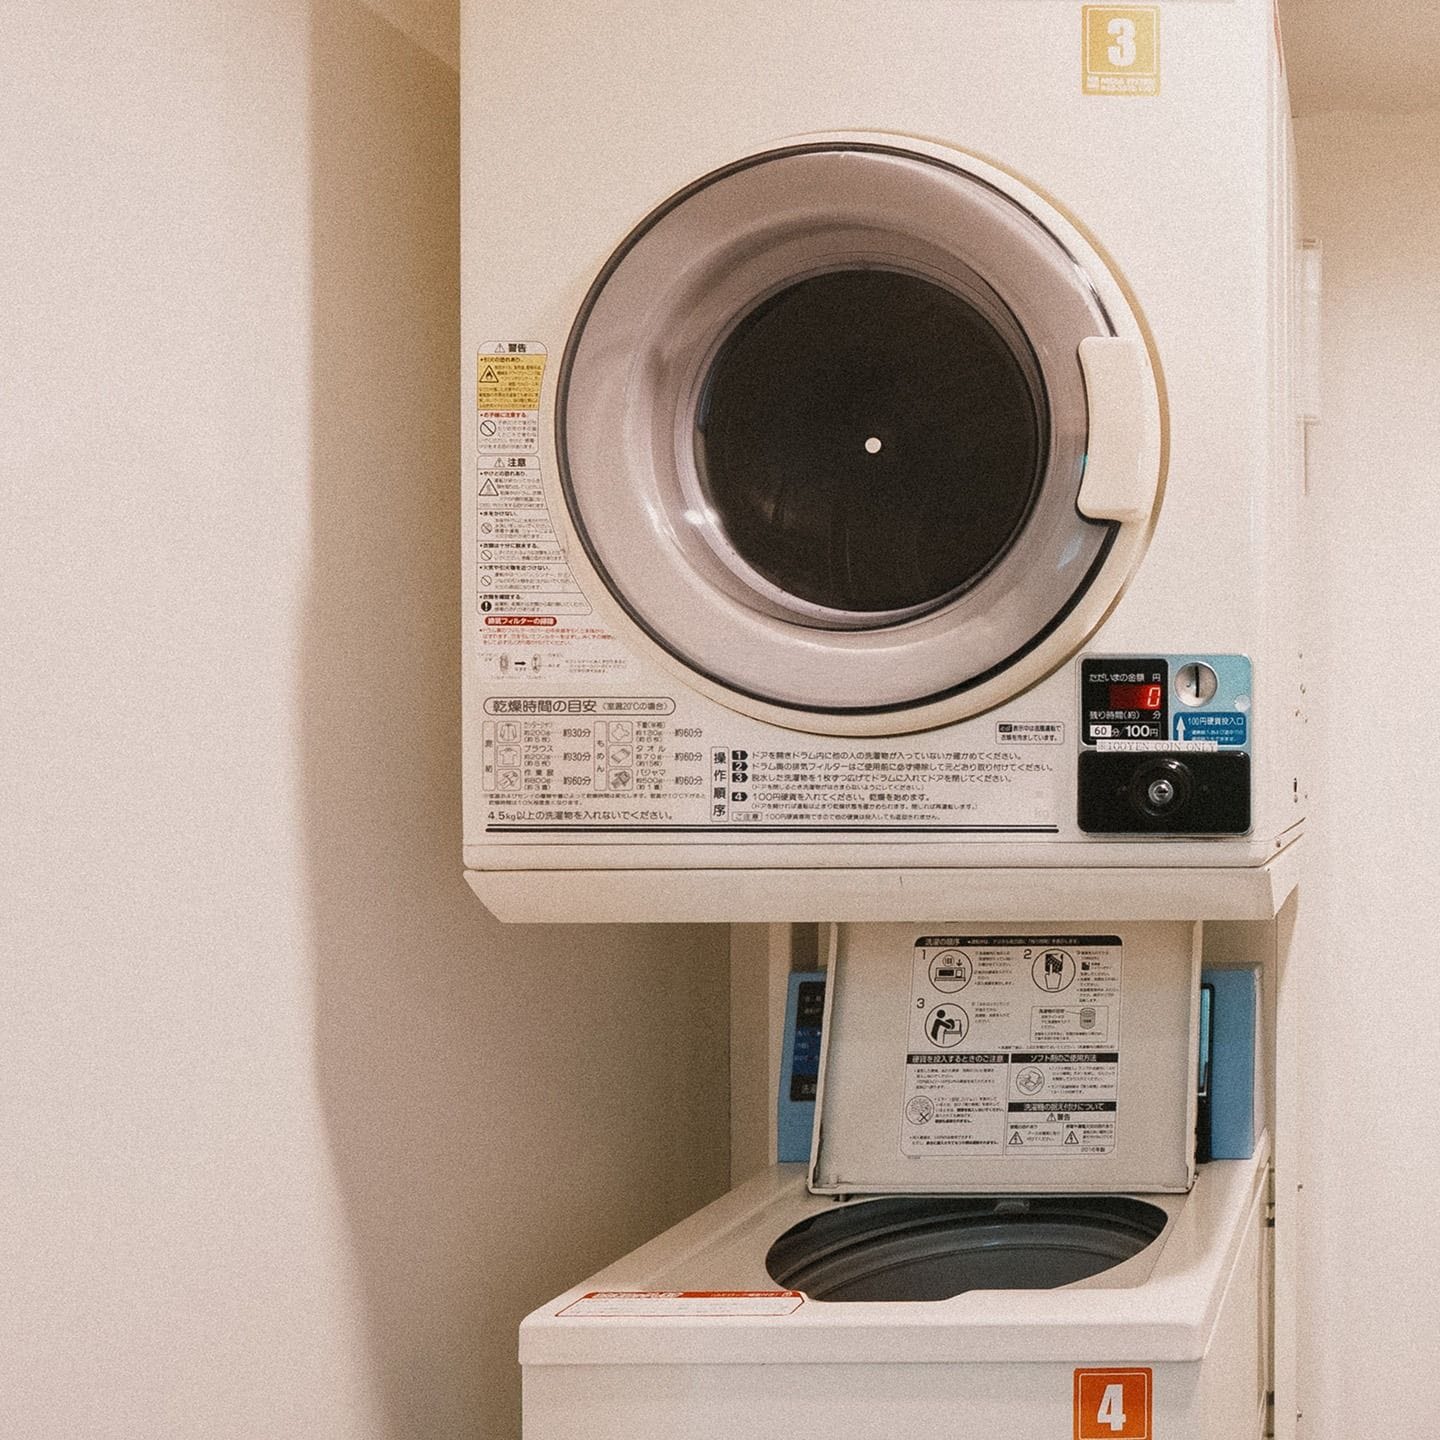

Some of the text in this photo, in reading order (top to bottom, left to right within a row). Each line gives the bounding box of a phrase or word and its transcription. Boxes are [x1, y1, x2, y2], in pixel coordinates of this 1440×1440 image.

[1107, 18, 1137, 67] 3
[507, 343, 527, 353] 警告
[507, 458, 527, 467] 注意
[1089, 673, 1161, 682] ただいまの金額 円
[493, 700, 597, 713] 乾燥時間の目安
[1152, 711, 1161, 719] 分
[1155, 743, 1181, 751] COIN
[1186, 743, 1216, 752] ONLY
[713, 752, 727, 817] 操作順序
[922, 948, 1032, 960] 1 2
[916, 997, 925, 1009] 3
[1057, 1113, 1070, 1121] 警告
[1097, 1384, 1126, 1431] 4
